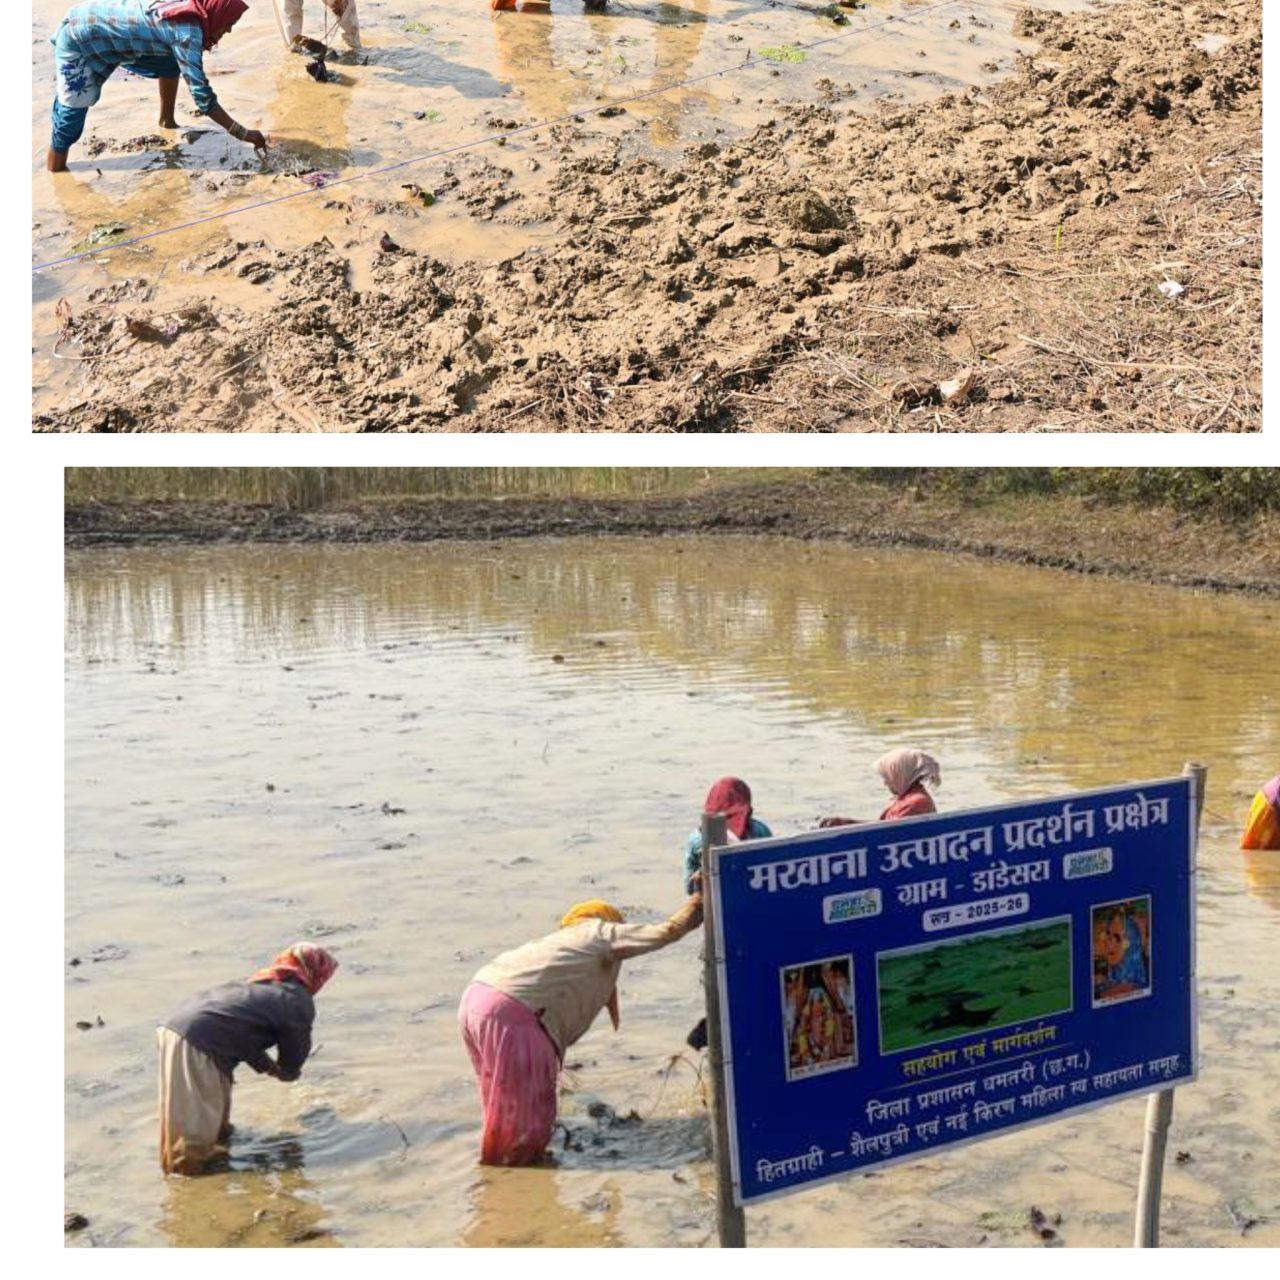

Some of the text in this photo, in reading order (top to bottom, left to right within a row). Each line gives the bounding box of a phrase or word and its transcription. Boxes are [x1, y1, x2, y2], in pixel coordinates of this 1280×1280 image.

[748, 792, 1169, 892] मखाना उत्पादन प्रदर्शन प्रक्षेत्र
[896, 877, 947, 906] ग्राम
[971, 860, 1051, 892] डांडेसरा
[967, 897, 1022, 919] 2025-26
[903, 1022, 1056, 1076] सहयोग एवं मार्गदर्शन
[756, 1145, 824, 1182] हितग्राही
[850, 1123, 910, 1156] शैलपुत्री
[916, 1115, 941, 1141] एवं
[946, 1103, 970, 1132] नई
[973, 1099, 1016, 1124] किरण
[1020, 1084, 1066, 1108] महिला
[1072, 1079, 1089, 1095] स्व
[1093, 1063, 1144, 1089] सहायता
[1148, 1054, 1181, 1078] समूह
[866, 1098, 911, 1124] जिला
[917, 1080, 976, 1110] प्रशासन
